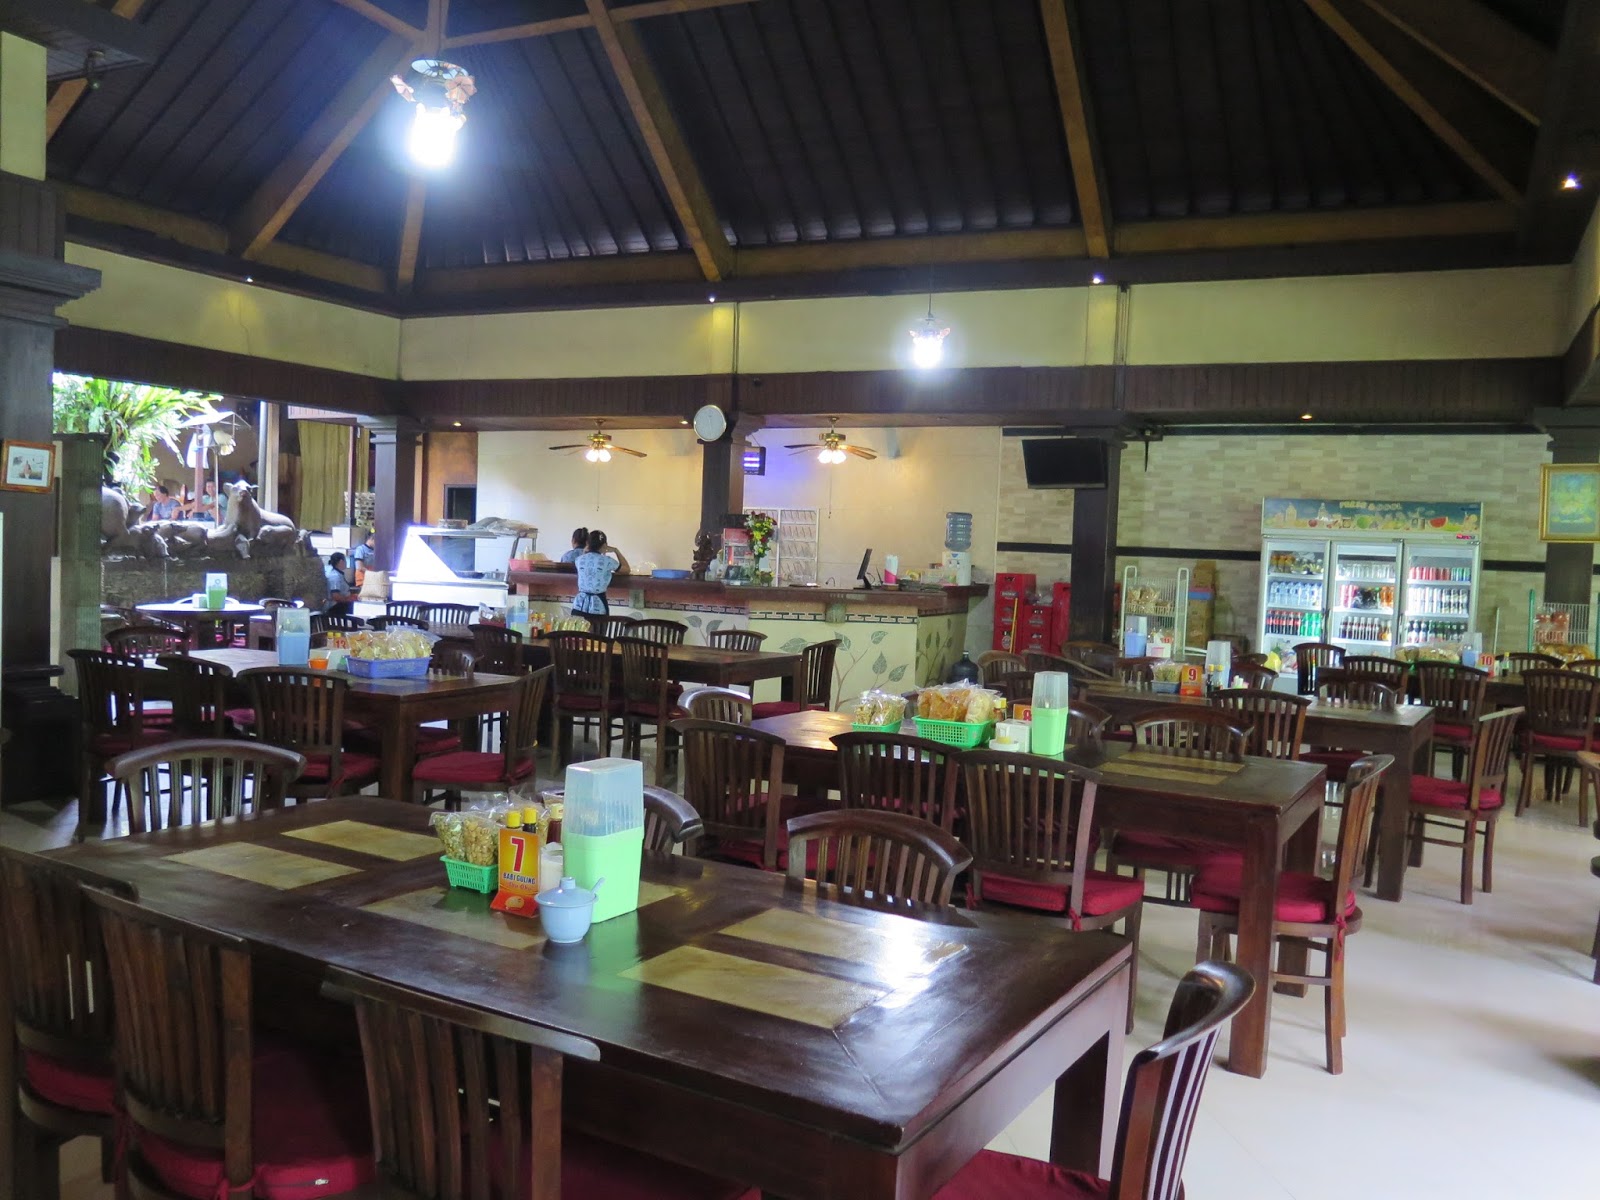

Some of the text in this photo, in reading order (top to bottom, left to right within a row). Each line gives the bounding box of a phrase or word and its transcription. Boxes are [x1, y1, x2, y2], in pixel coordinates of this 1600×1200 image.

[1480, 655, 1493, 666] 10
[1188, 668, 1197, 681] 9
[511, 836, 525, 873] 7
[503, 872, 516, 881] BABI
